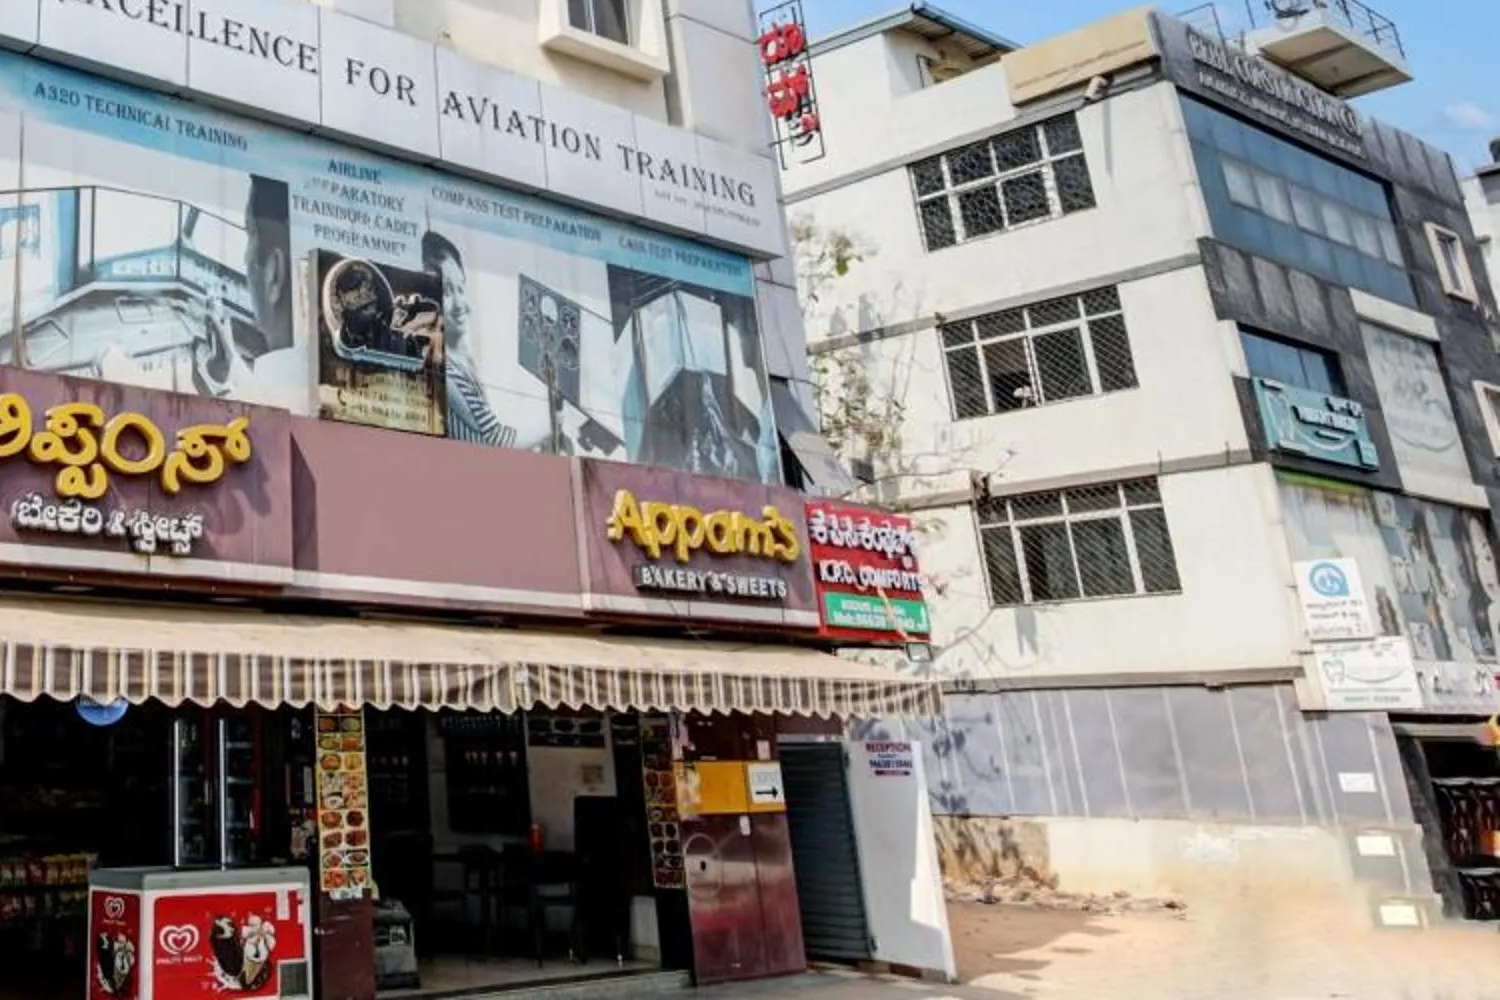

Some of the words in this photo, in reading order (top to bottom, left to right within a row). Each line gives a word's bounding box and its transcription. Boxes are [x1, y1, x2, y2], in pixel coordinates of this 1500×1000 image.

[34, 81, 81, 107] A320
[175, 119, 248, 151] TRAINING
[346, 56, 416, 106] FOR
[442, 90, 601, 161] AVIATION
[616, 143, 756, 208] TRAINING
[327, 158, 382, 185] AIRLINE
[431, 185, 489, 214] COMPASS
[491, 201, 520, 222] TEST
[374, 214, 418, 239] CADET
[606, 488, 799, 566] Appam's
[641, 564, 707, 592] BAKERY
[726, 575, 788, 598] SWEETS
